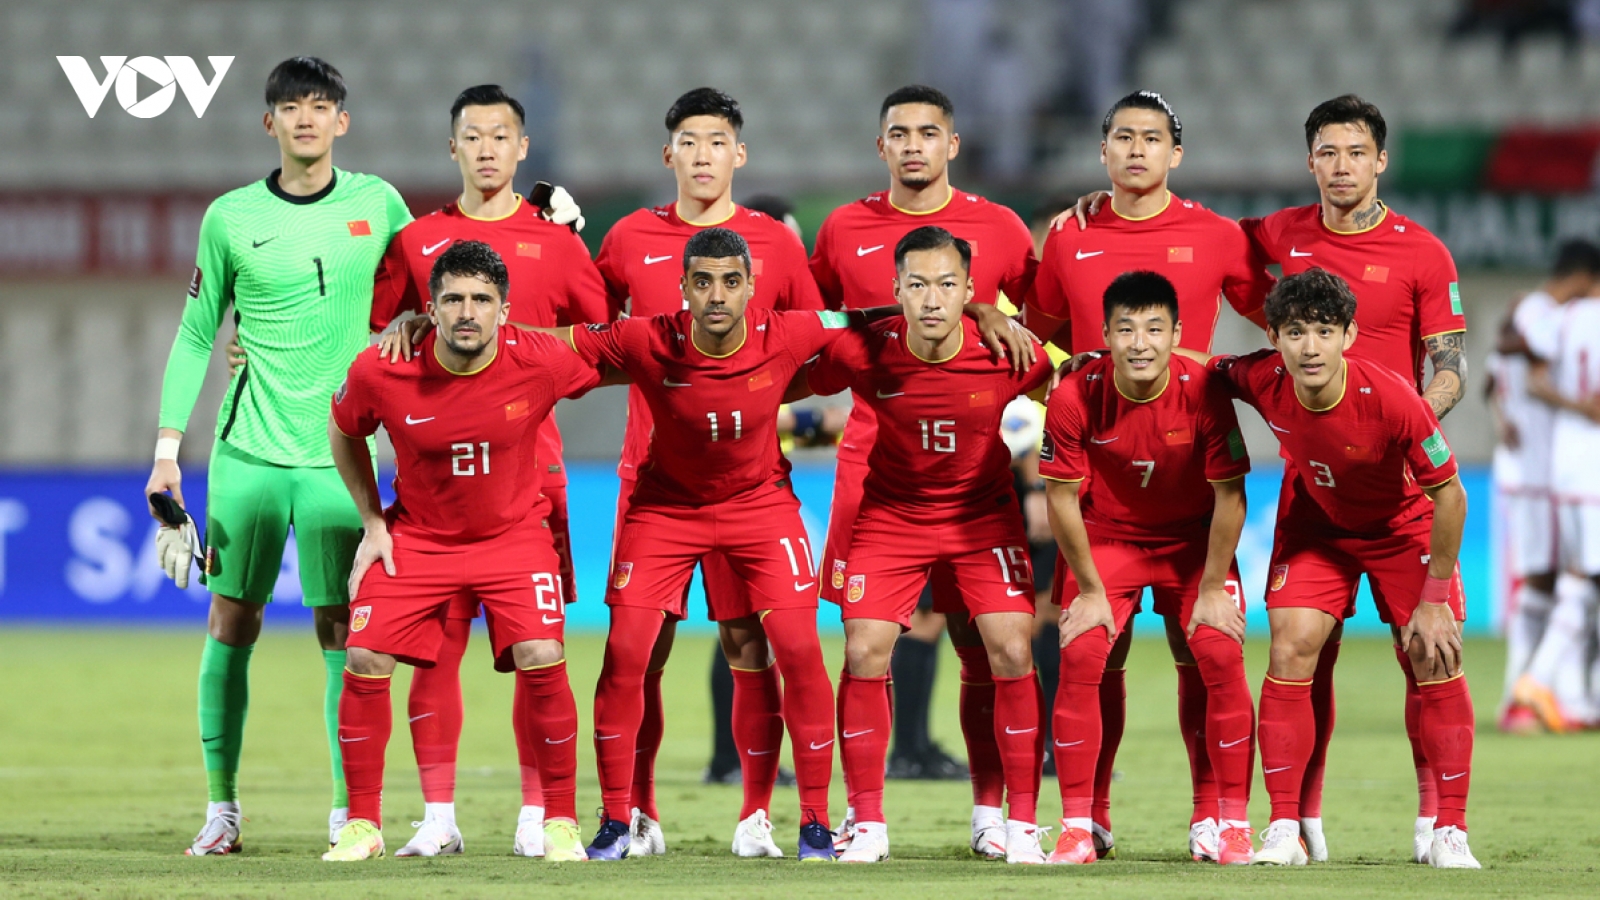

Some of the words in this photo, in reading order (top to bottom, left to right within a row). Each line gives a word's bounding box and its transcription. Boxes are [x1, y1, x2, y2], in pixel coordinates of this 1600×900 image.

[313, 256, 326, 297] 1
[706, 411, 742, 442] 11
[918, 419, 956, 453] 15
[452, 442, 491, 476] 21
[1132, 461, 1155, 488] 7
[1309, 460, 1336, 488] 3
[780, 537, 815, 578] 11
[993, 546, 1032, 585] 15
[532, 572, 564, 612] 21
